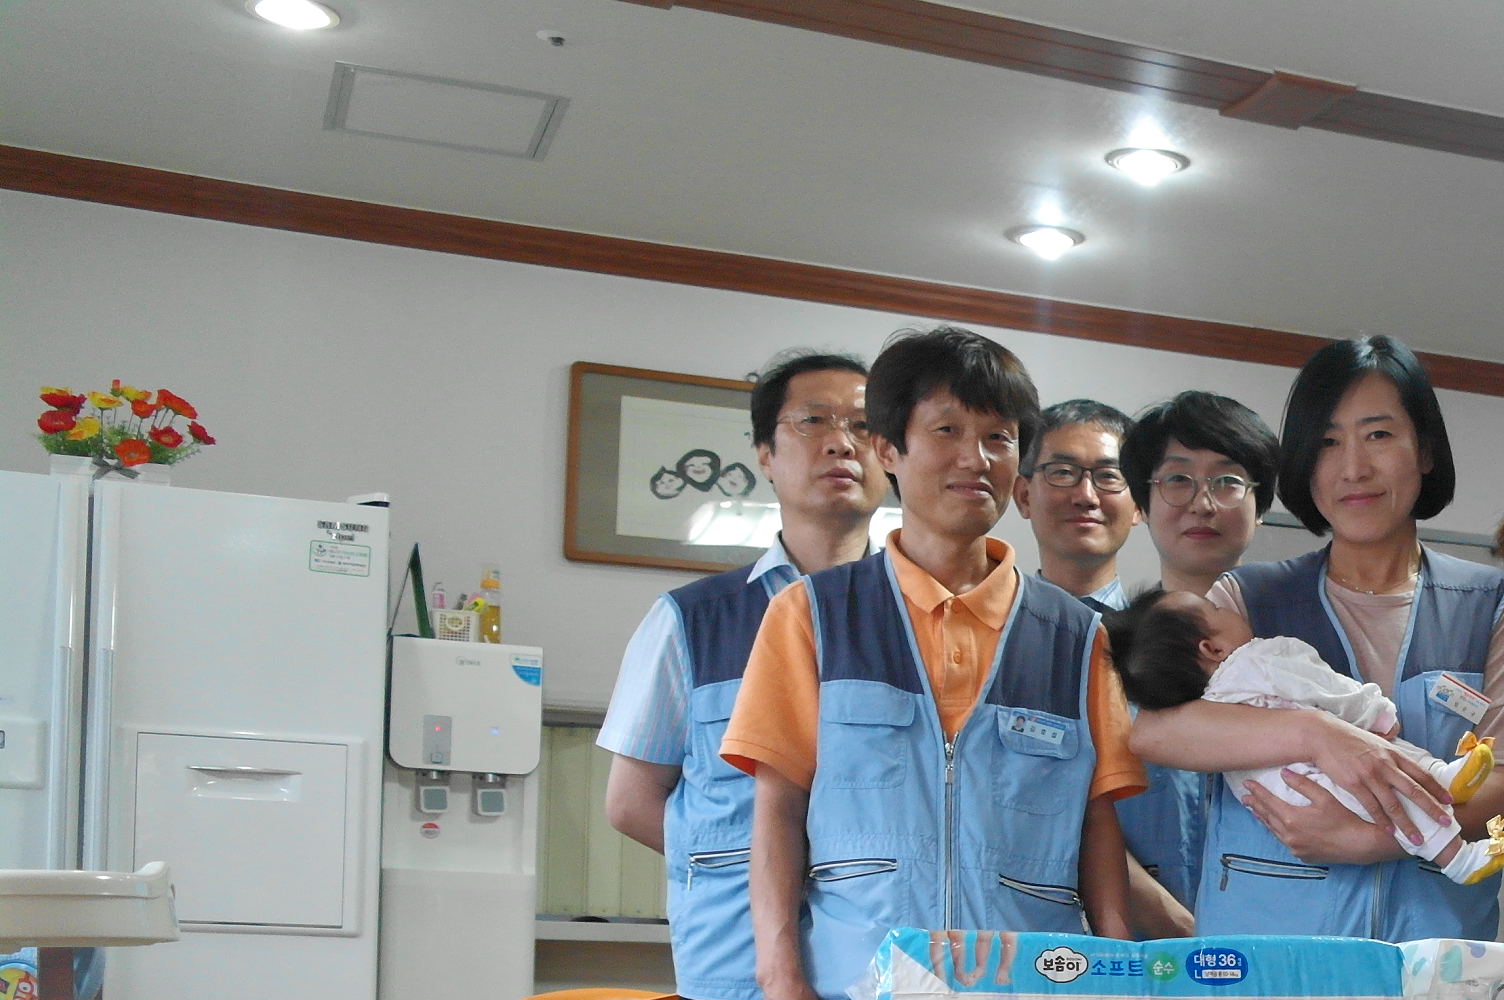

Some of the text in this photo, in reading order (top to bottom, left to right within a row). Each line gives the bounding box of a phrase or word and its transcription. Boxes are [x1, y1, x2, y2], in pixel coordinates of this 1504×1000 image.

[1043, 956, 1175, 976] 보솜이 소프트 순수
[1194, 954, 1236, 966] 대형 36
